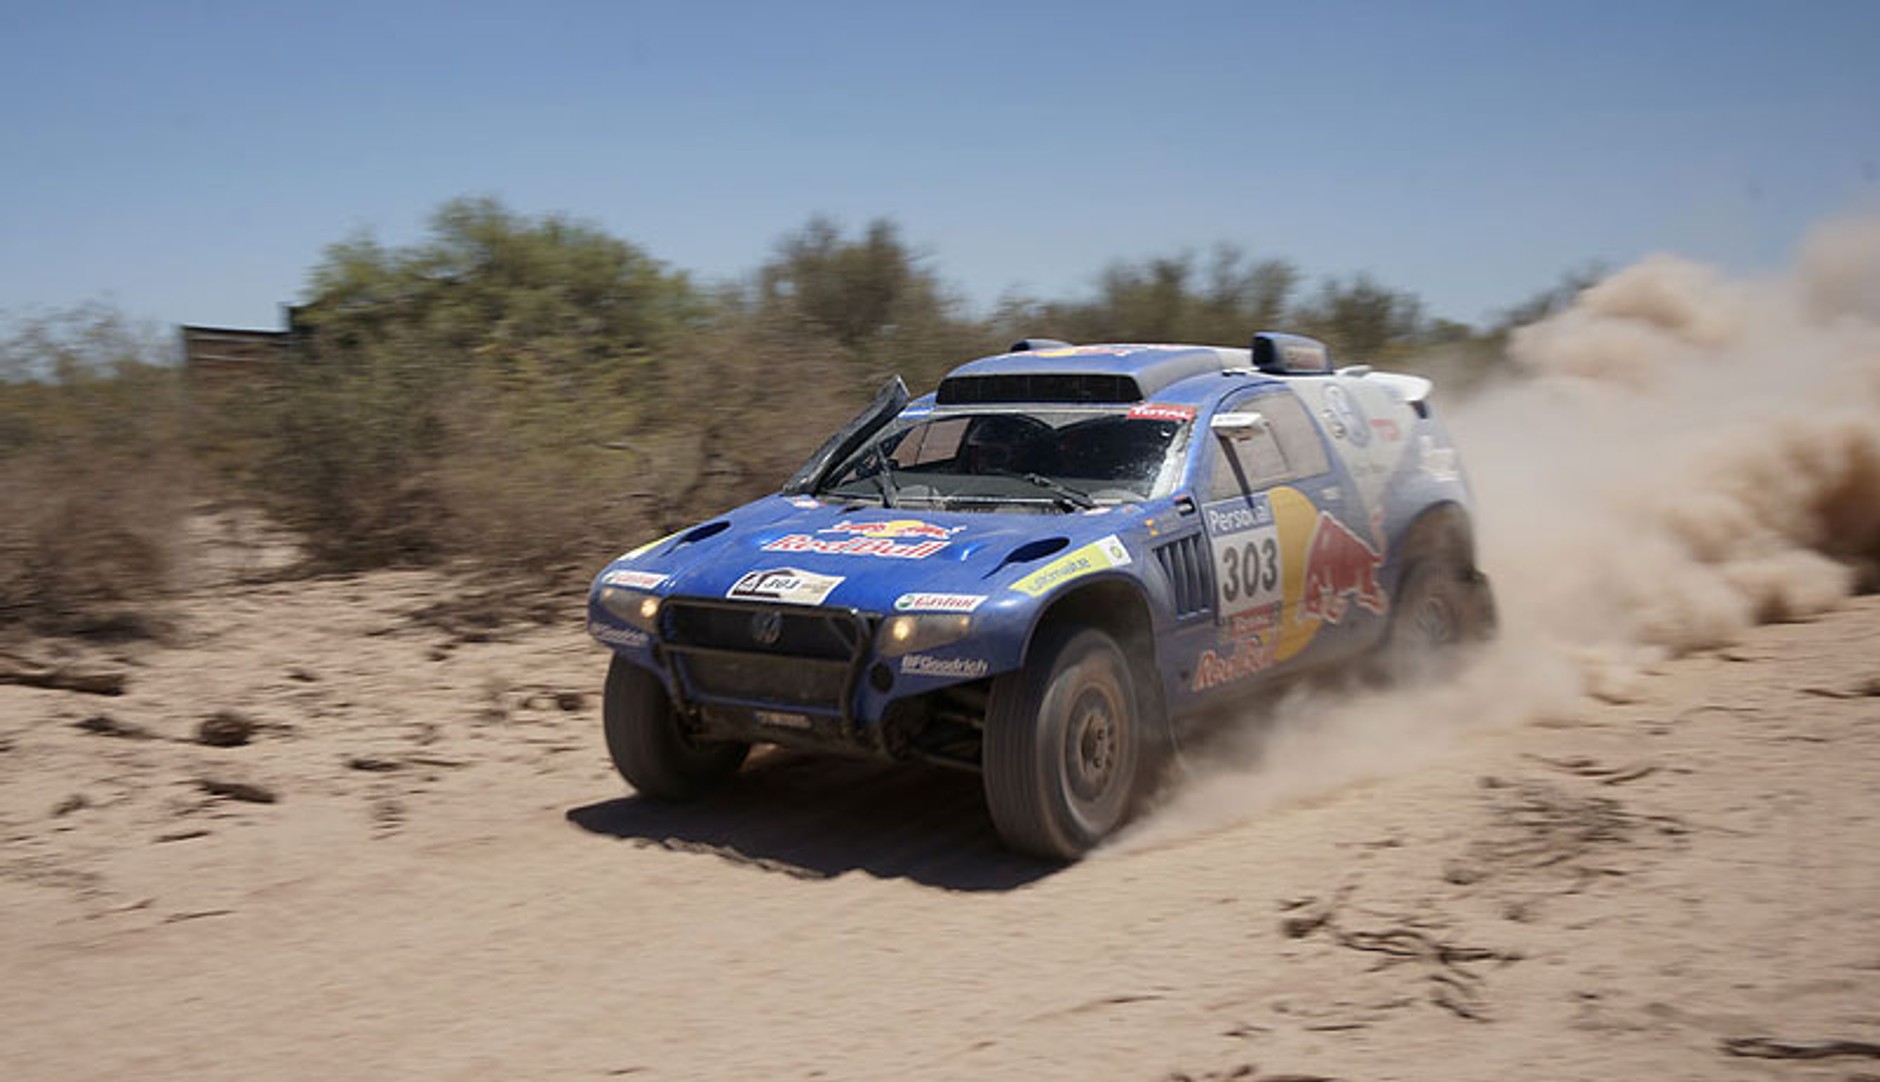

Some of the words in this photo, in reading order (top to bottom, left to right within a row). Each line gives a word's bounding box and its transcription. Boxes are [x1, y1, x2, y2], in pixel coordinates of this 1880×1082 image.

[1131, 404, 1192, 420] TOTAL
[761, 534, 863, 554] Red
[845, 537, 951, 559] Bull
[1223, 538, 1277, 602] 303
[902, 654, 988, 678] BFGoodrich
